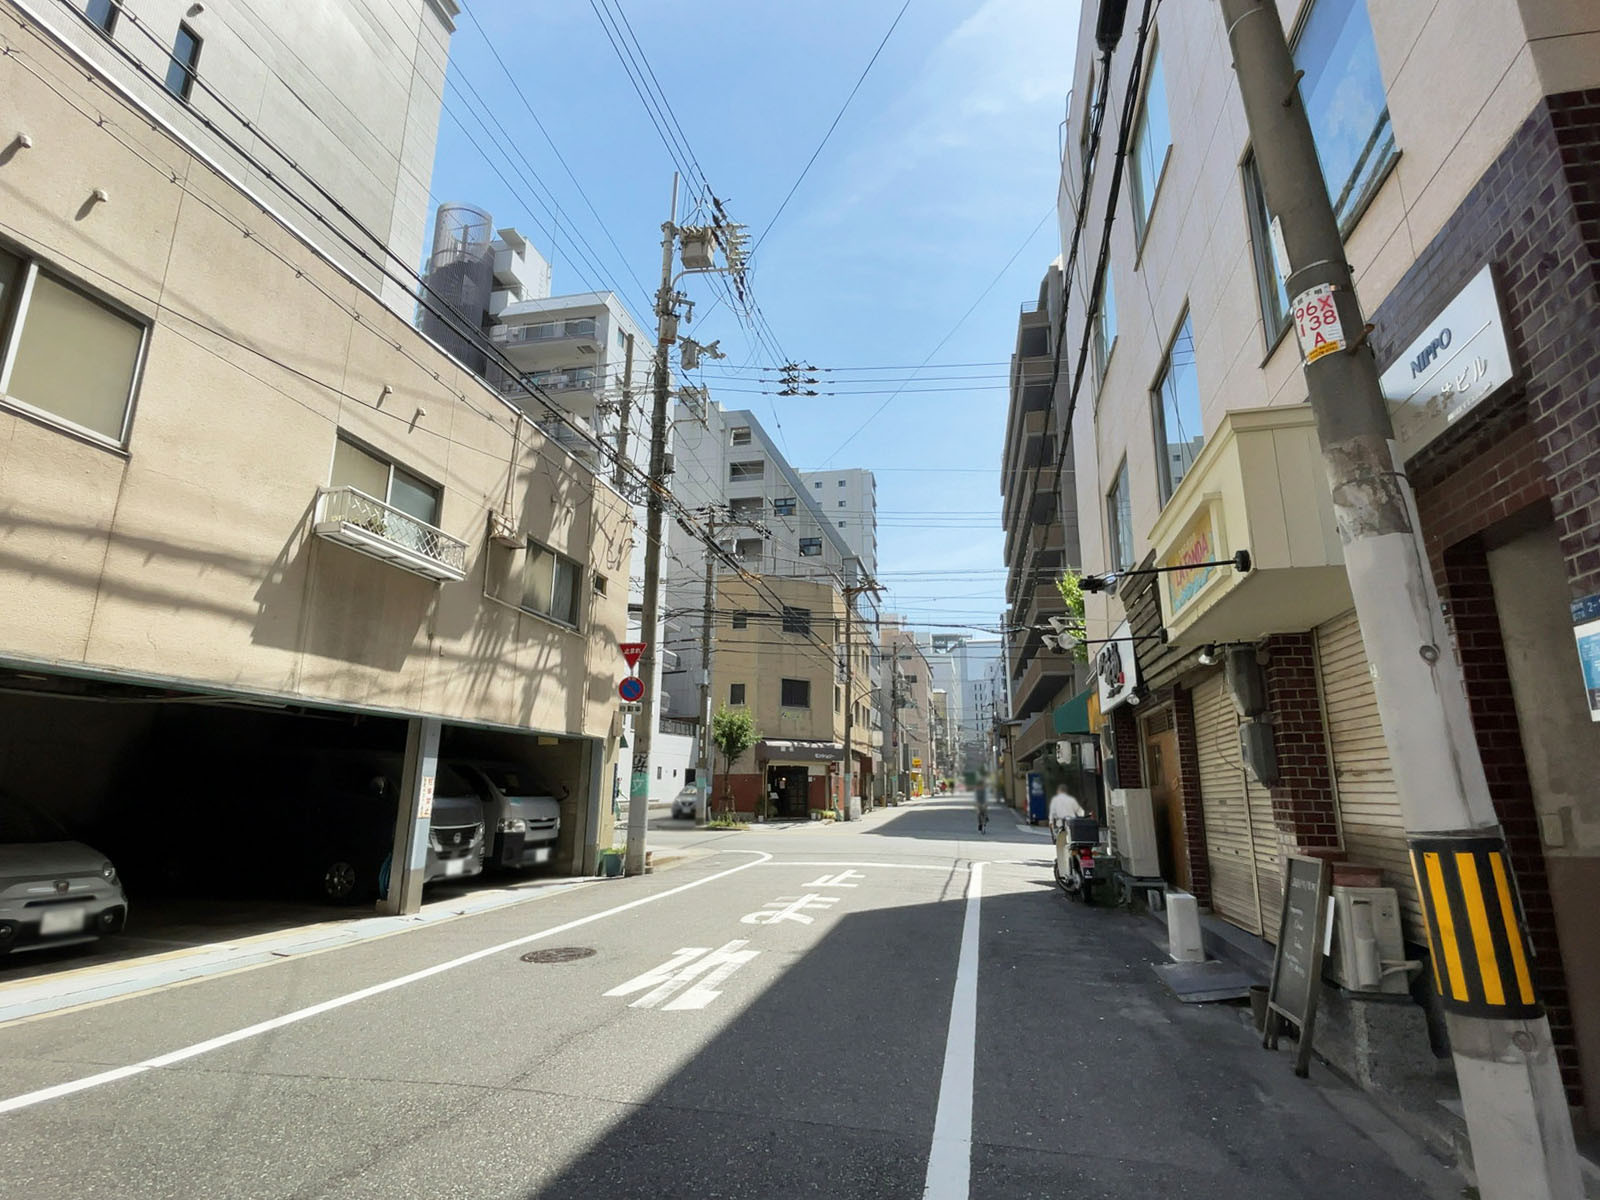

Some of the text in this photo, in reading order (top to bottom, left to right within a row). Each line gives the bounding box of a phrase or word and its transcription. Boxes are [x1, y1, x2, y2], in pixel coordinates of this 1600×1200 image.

[1296, 295, 1333, 323] 96X
[1300, 309, 1337, 337] 138
[1315, 331, 1327, 348] A
[1410, 328, 1452, 379] NIPPO
